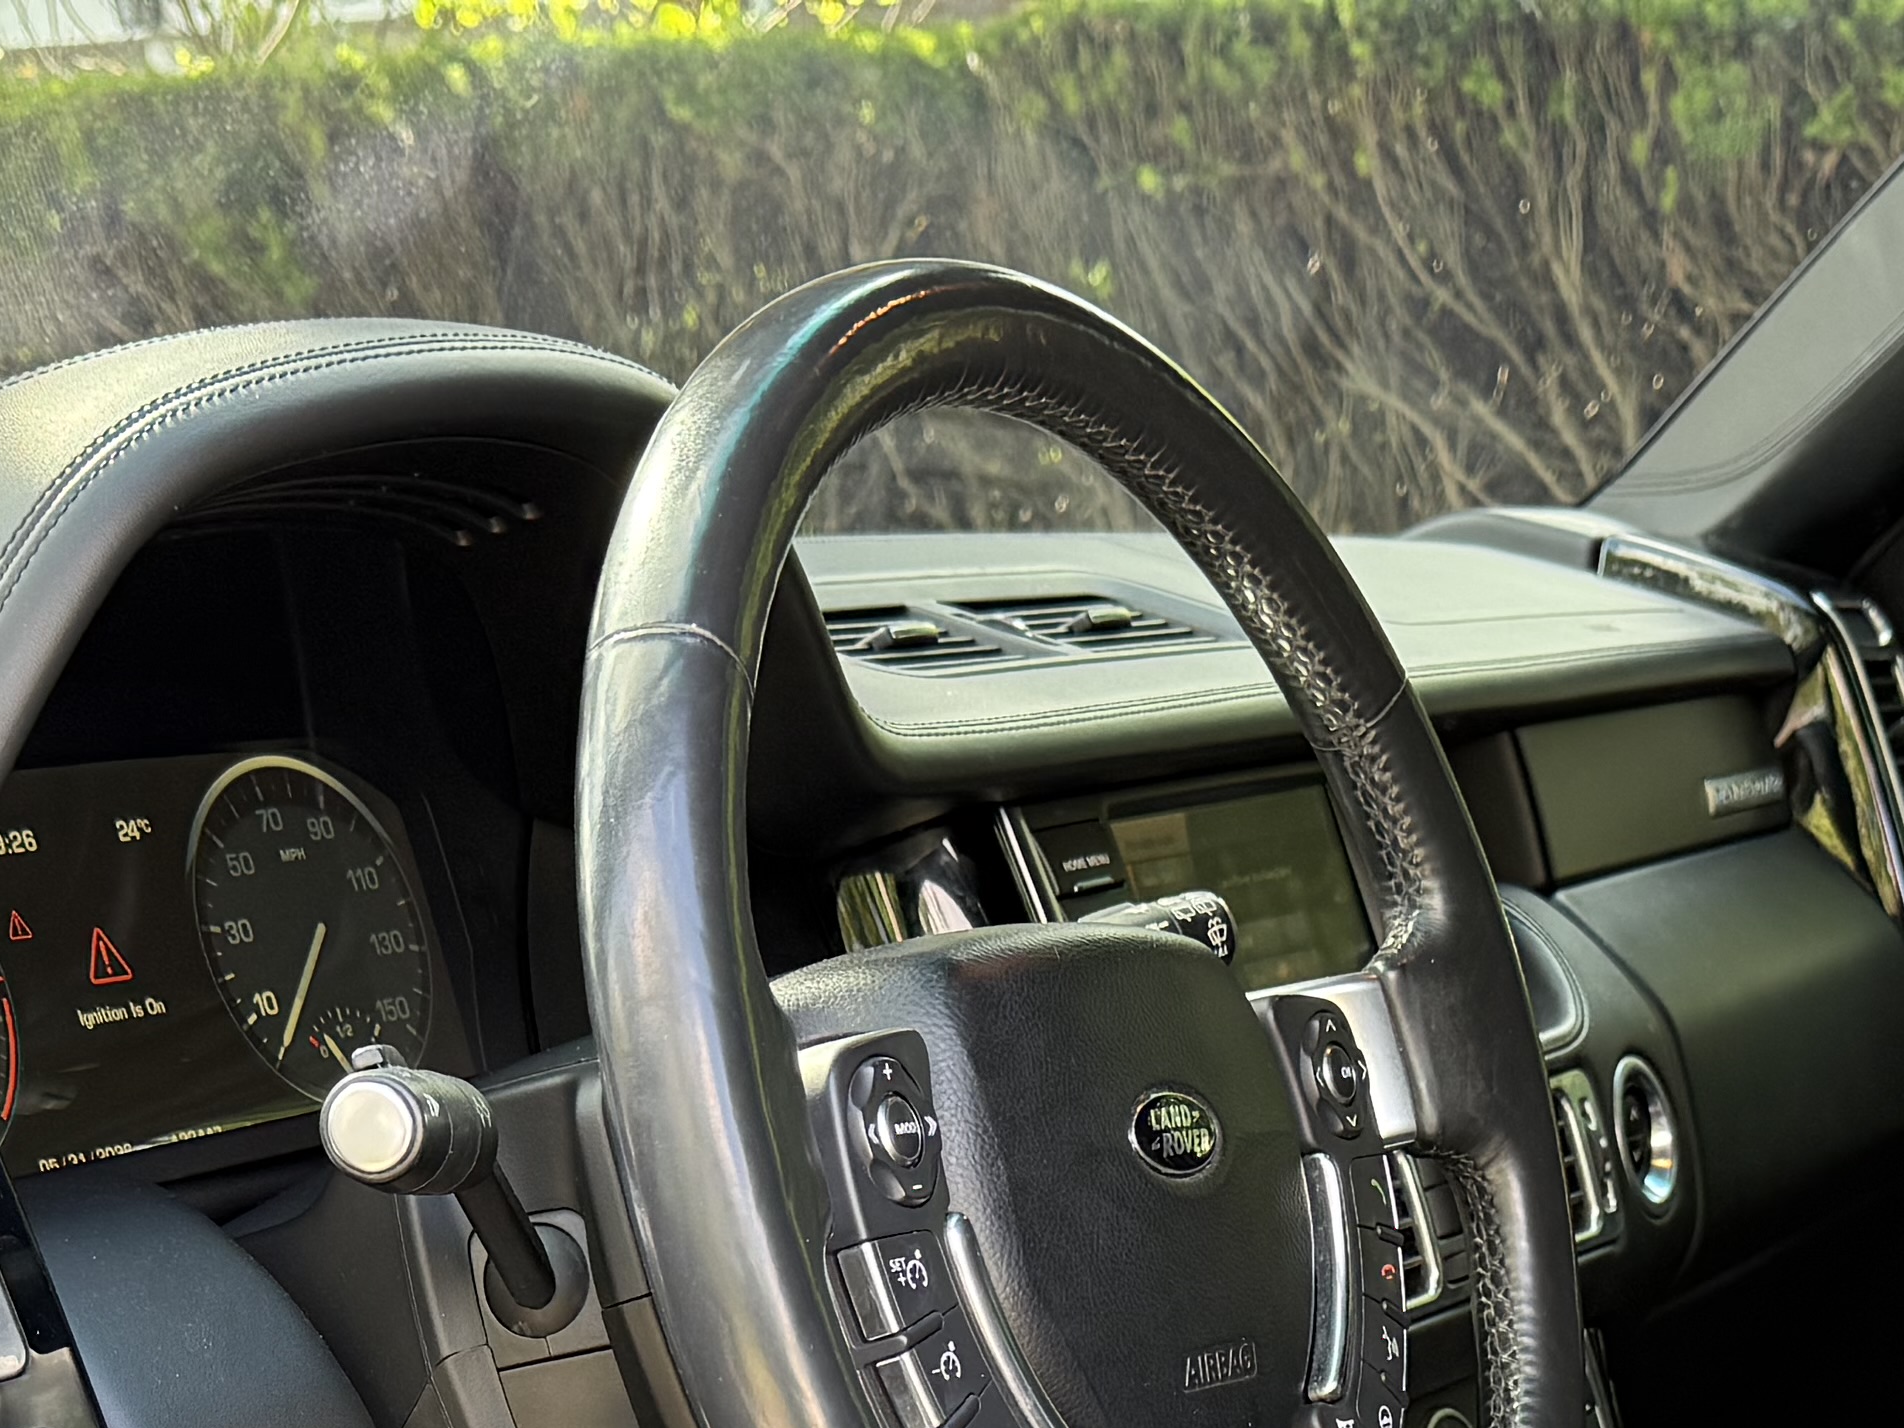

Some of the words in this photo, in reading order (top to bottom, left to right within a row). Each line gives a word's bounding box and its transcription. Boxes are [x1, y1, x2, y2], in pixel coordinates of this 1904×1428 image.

[255, 807, 283, 832] 70
[306, 815, 335, 841] 90
[226, 852, 256, 877] 50
[279, 848, 307, 863] MPH
[346, 866, 379, 891] 110
[223, 919, 254, 945] 30
[369, 930, 405, 956] 130
[76, 1004, 129, 1030] Ignition
[129, 1000, 145, 1019] Is
[145, 997, 167, 1015] On
[252, 990, 280, 1017] 10
[375, 996, 410, 1022] 150
[1149, 1104, 1192, 1131] LAND
[1162, 1128, 1211, 1158] ROVER
[889, 1257, 907, 1273] SET
[1184, 1343, 1252, 1388] AIRBAG
